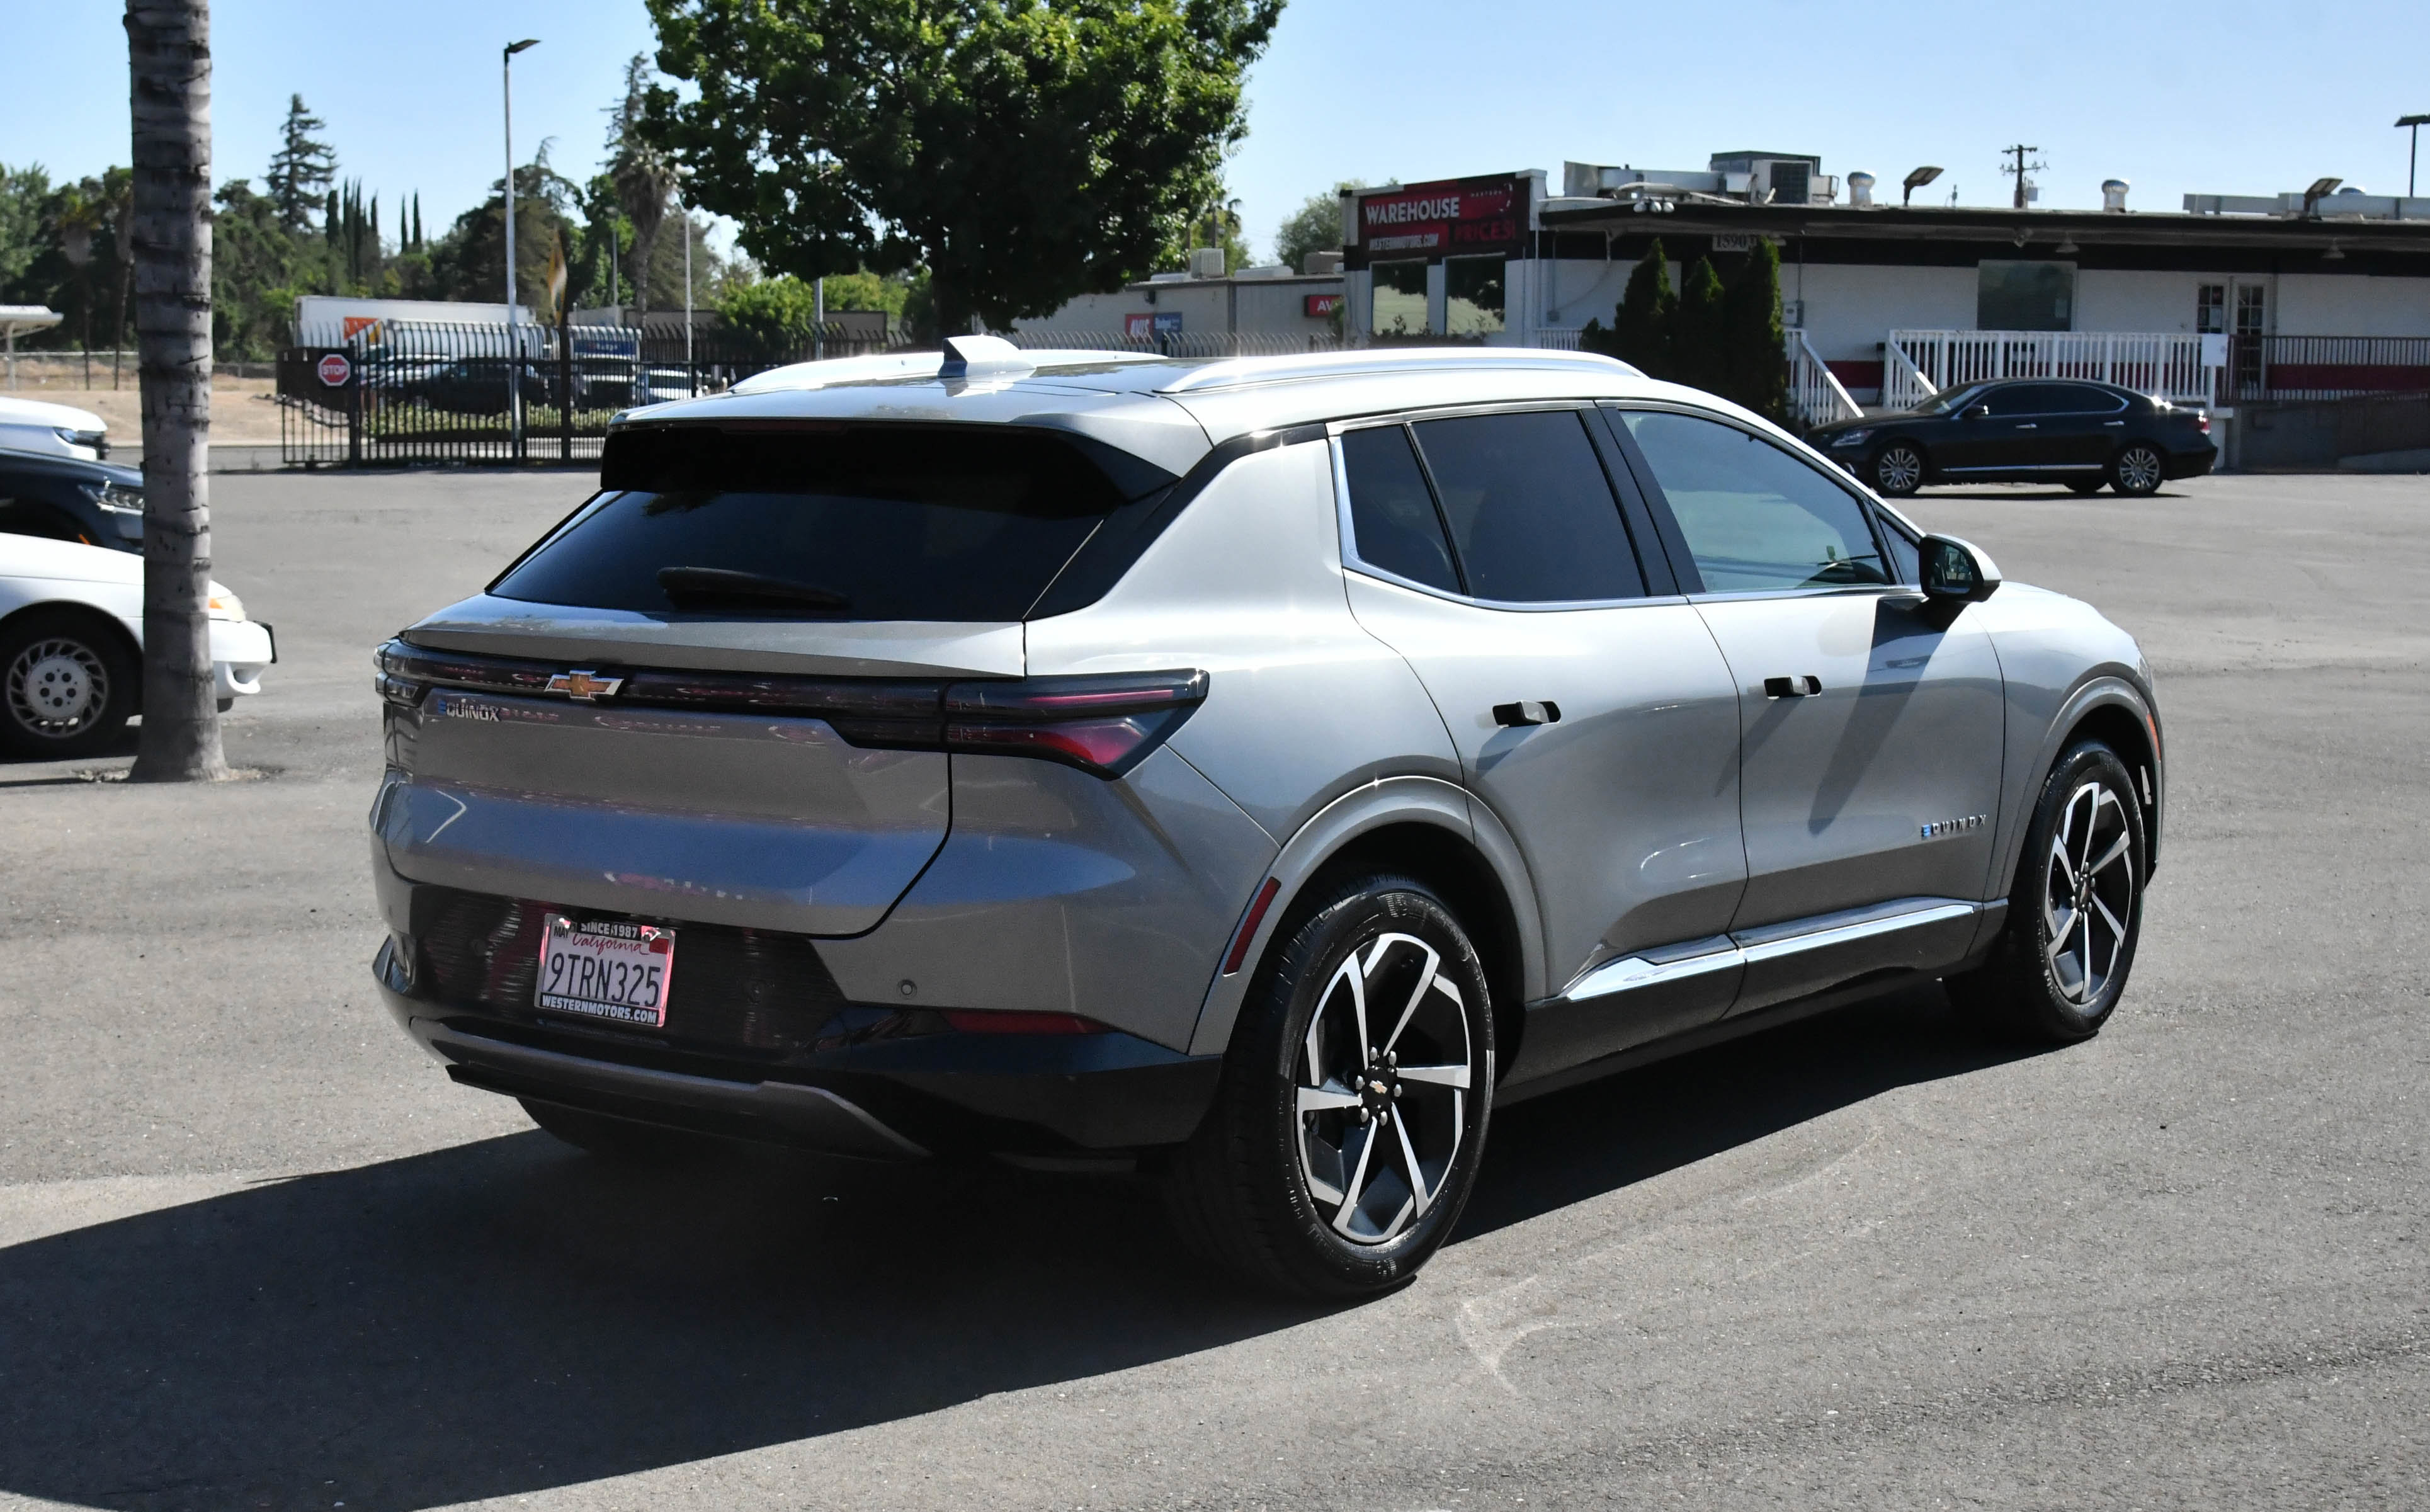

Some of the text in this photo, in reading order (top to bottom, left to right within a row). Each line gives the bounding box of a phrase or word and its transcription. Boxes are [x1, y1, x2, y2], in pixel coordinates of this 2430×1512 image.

[1365, 196, 1460, 225] WAREHOUSE
[321, 365, 348, 375] STOP
[438, 700, 499, 722] EQUINOX
[1922, 814, 1987, 837] EQUINOX
[554, 926, 569, 938] MAY
[581, 922, 639, 939] SINCE 1987
[572, 933, 650, 955] California
[548, 952, 661, 1008] 9TRN325
[542, 994, 657, 1023] WESTERNMOTORS.COM
